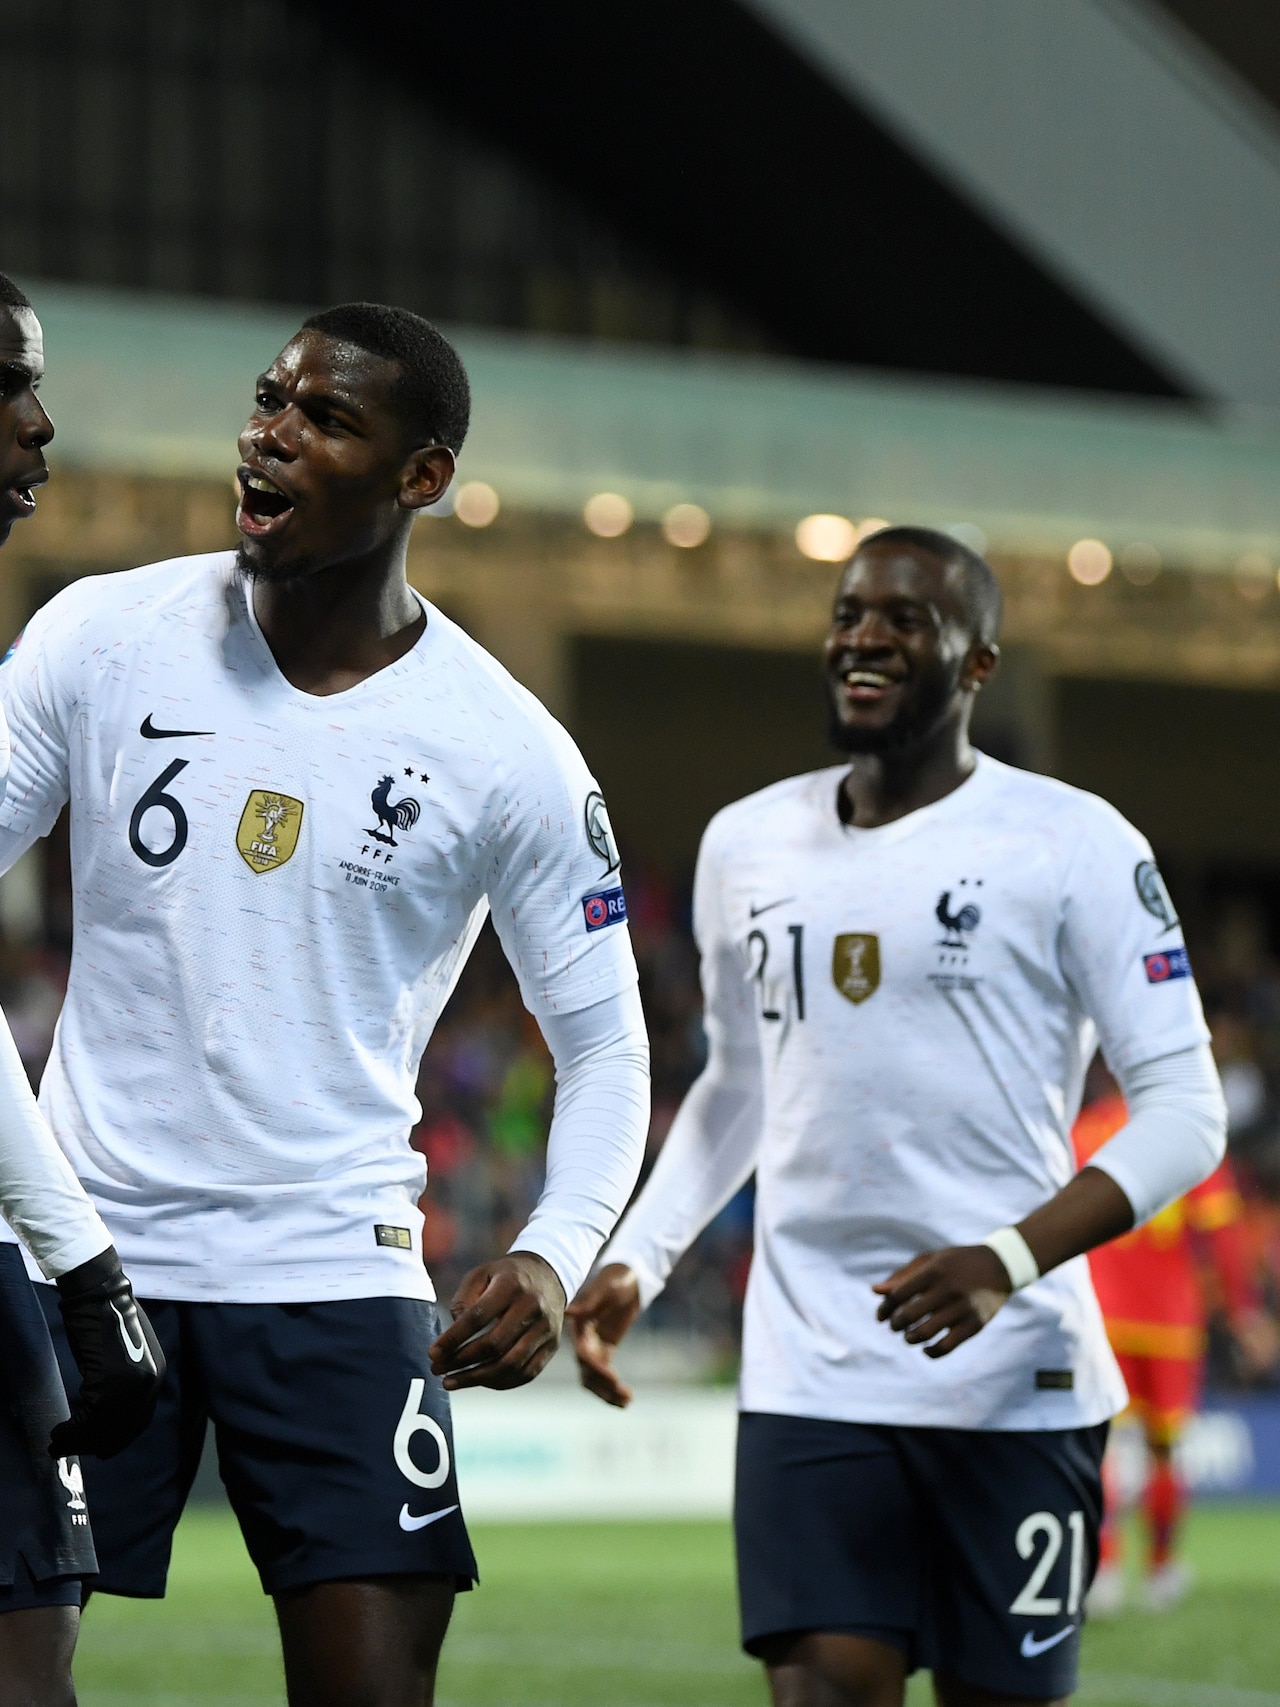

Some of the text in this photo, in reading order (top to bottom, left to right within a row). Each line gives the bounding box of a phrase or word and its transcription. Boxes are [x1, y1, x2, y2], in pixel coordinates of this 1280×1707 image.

[129, 757, 190, 867] 6
[251, 841, 277, 856] FIFA
[339, 860, 401, 886] ANDORRE-FRANCE
[352, 875, 369, 887] JUIN
[369, 881, 388, 893] 2019
[393, 1378, 450, 1489] 6
[1008, 1509, 1085, 1616] 21
